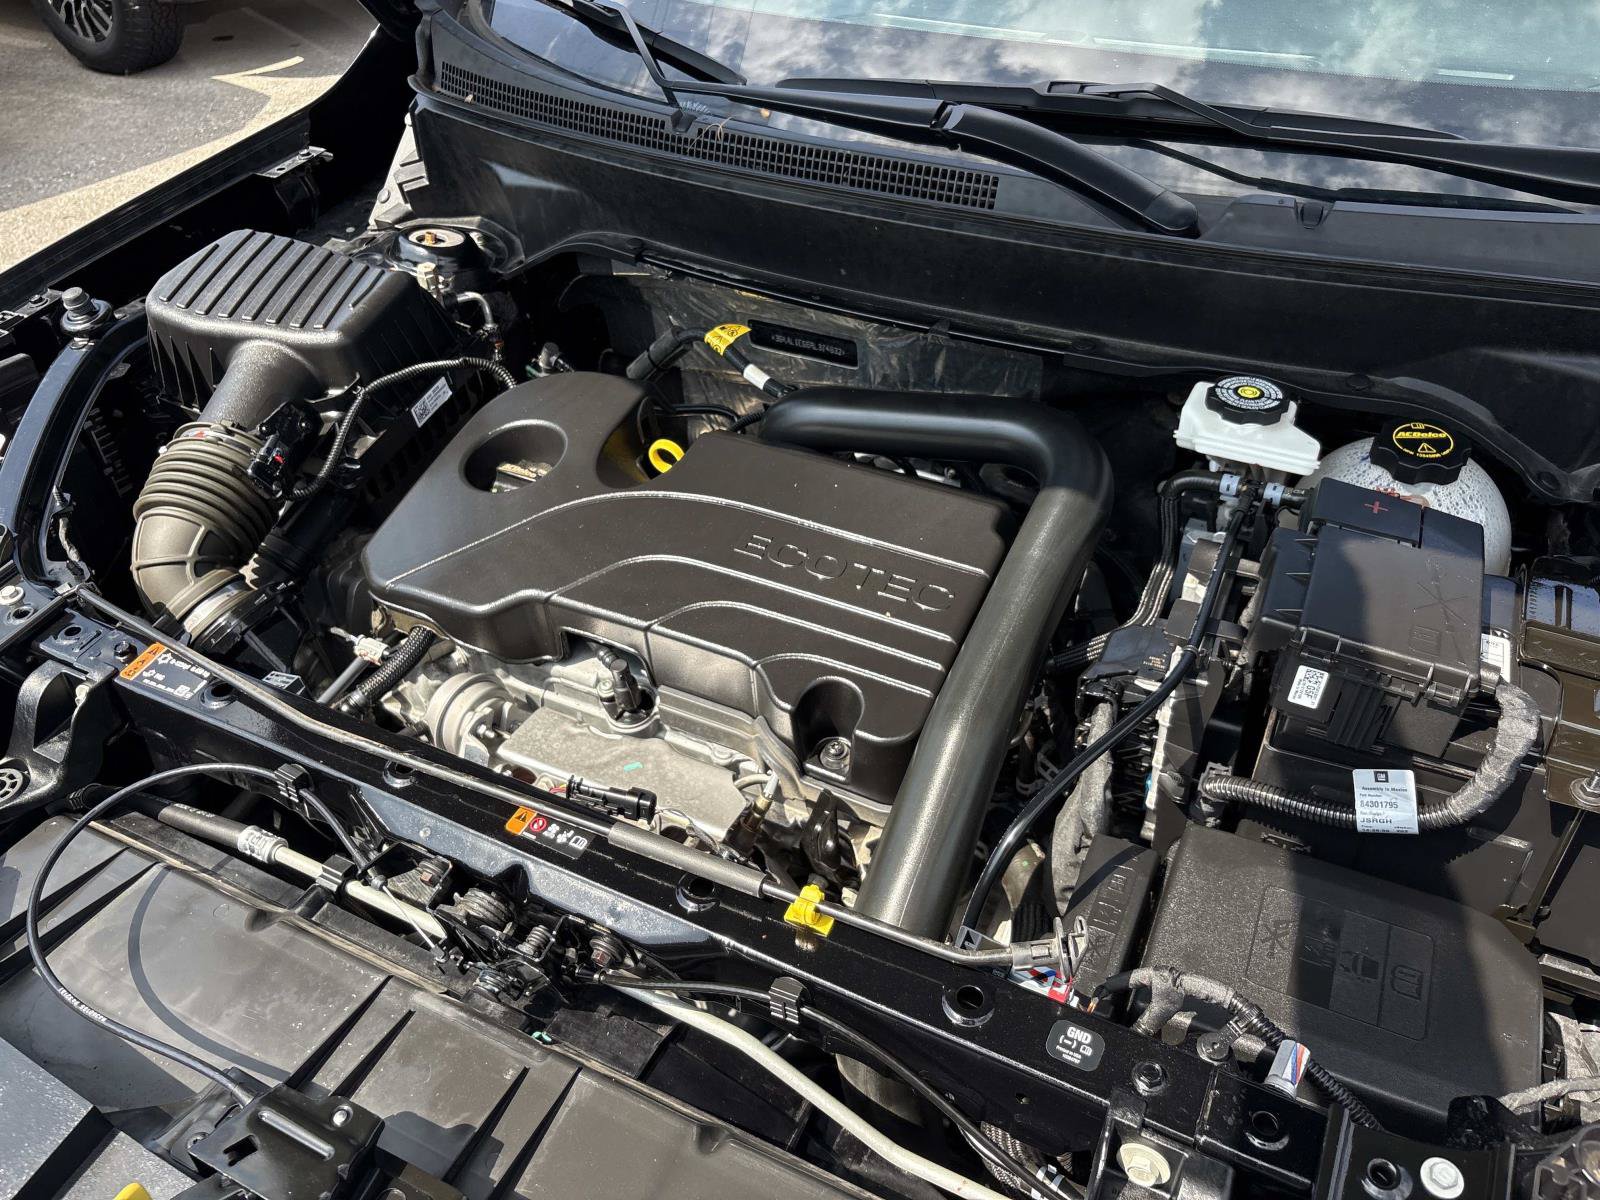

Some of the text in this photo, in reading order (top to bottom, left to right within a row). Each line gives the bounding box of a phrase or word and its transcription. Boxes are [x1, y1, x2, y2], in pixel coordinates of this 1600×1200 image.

[734, 534, 955, 612] ECOTEC
[1360, 800, 1399, 809] 84301795
[1067, 1026, 1092, 1044] GND
